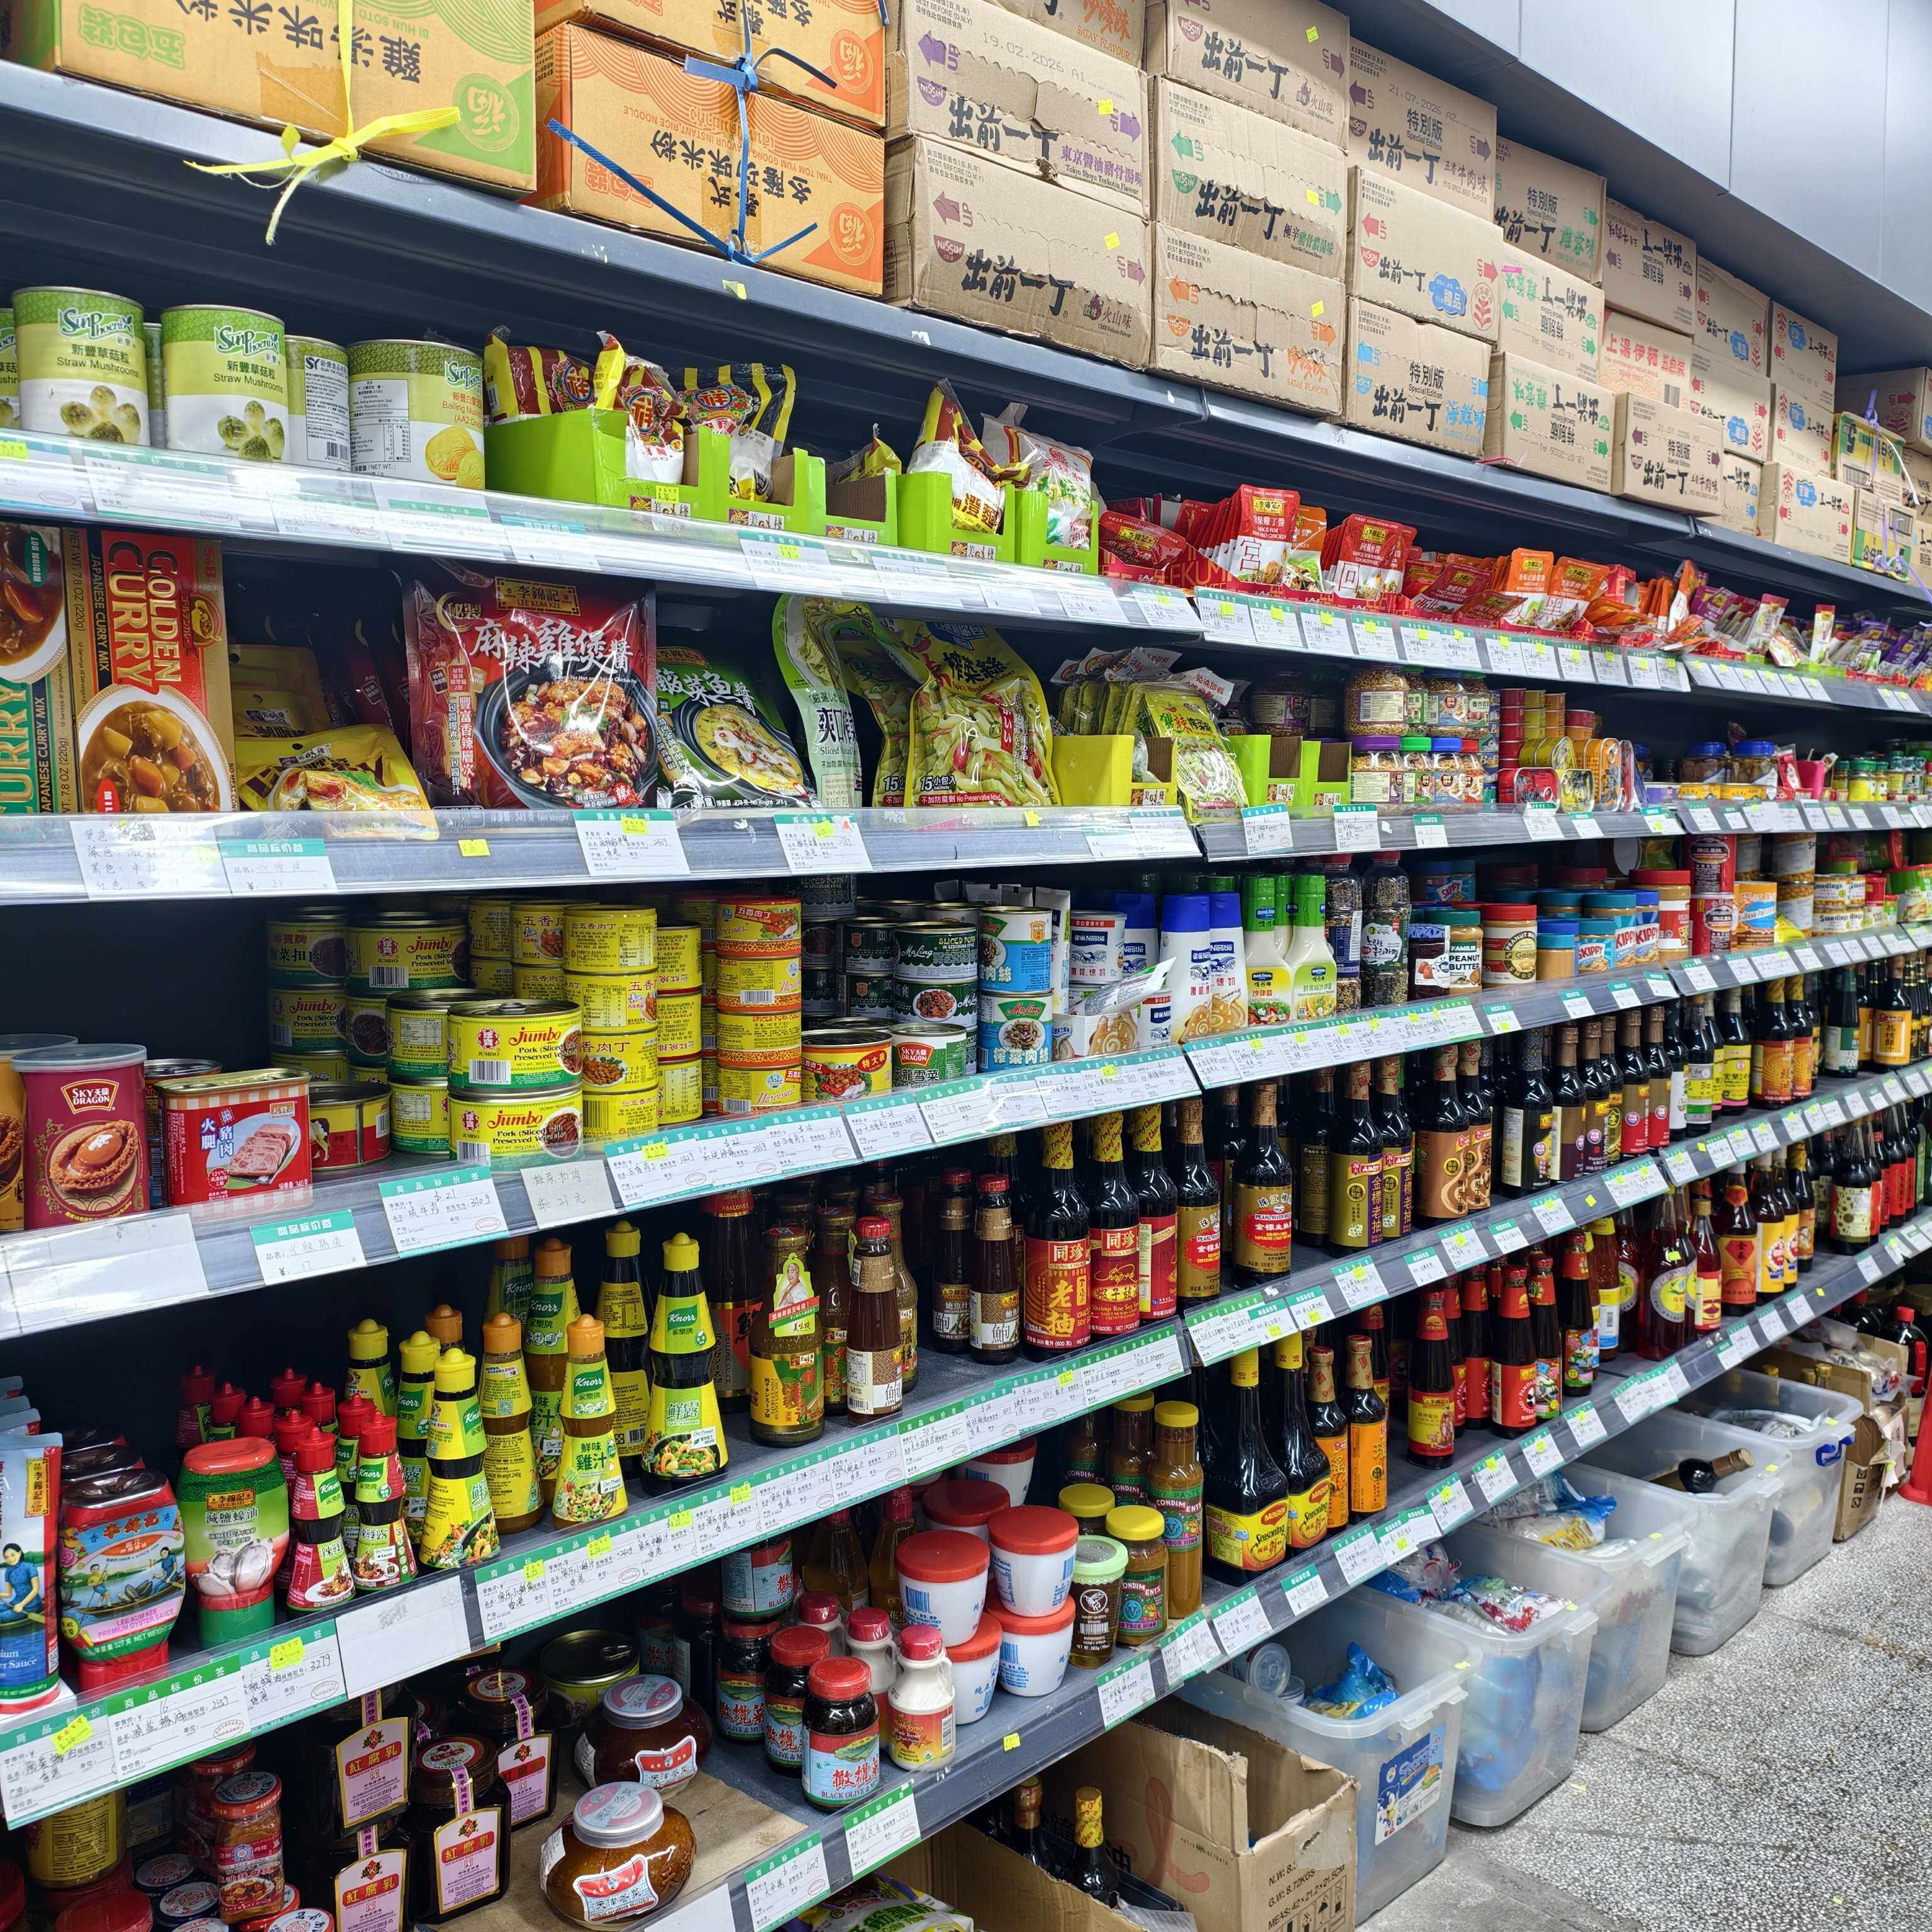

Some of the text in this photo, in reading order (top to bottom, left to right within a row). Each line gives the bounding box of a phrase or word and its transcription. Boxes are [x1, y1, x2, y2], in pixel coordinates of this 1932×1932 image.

[931, 3, 953, 18] BEFORE
[360, 10, 429, 39] BI HUN SOTO
[78, 4, 185, 69] 五包裝
[1077, 25, 1131, 61] SATAY FLAVOUR
[947, 43, 961, 71] UP
[982, 31, 1065, 73] 19.02.2026
[1322, 48, 1330, 70] UP
[1201, 30, 1289, 100] 出前一丁
[921, 83, 944, 99] NISSIN
[1367, 89, 1375, 110] UP
[948, 96, 1060, 161] 出前一丁
[1406, 107, 1443, 143] 特別版
[623, 105, 833, 184] THAI TOM YUM GOONG INSTANT RICE NOODLE
[1406, 130, 1426, 145] Special
[1367, 128, 1441, 185] 出前一丁
[943, 162, 965, 177] BEFORE
[1194, 179, 1285, 240] 出前一丁
[1526, 186, 1558, 216] 特別版
[962, 201, 974, 228] UP
[1379, 219, 1387, 241] UP
[1494, 205, 1557, 253] 出前一丁
[936, 238, 963, 256] NISSIN
[1641, 228, 1682, 269] 出前一丁
[1116, 255, 1126, 279] UP
[1379, 255, 1426, 293] 出前一丁
[960, 248, 1075, 316] 出前一丁
[1541, 276, 1588, 323] 出前一丁
[1101, 306, 1132, 330] 火山味
[71, 343, 131, 365] 新豐草菇粒
[1190, 323, 1275, 379] 出前一丁
[57, 357, 140, 378] Straw Mushrooms
[226, 360, 277, 381] 新豐草菇粒
[1409, 361, 1445, 391] 特別版
[213, 373, 284, 394] Straw Mushrooms
[1305, 383, 1330, 397] FLAVOUR
[1409, 383, 1443, 400] Special Edition
[442, 401, 465, 414] Bailing
[1372, 384, 1443, 433] 出前一丁
[1552, 383, 1599, 425] 出前一丁
[1667, 439, 1691, 461] 特別版
[1642, 459, 1689, 496] 出前一丁
[31, 553, 42, 582] MEDIUM
[517, 584, 561, 604] 李錦記
[517, 597, 562, 610] LEE KUM KEE
[91, 553, 109, 672] JAPANESE CURRY MIX
[108, 540, 153, 689] CURRY
[146, 550, 182, 682] GOLDEN
[469, 617, 634, 675] 麻辣雞煲醬
[34, 696, 49, 758] CURRY MIX
[58, 736, 69, 784] OZ (220g)
[819, 746, 840, 756] Sliced
[921, 794, 956, 805] 不加防腐劑
[1441, 881, 1462, 898] SKIPPY
[938, 937, 961, 945] SLICED
[1577, 942, 1604, 959] SKIPPY
[1448, 954, 1480, 963] PEANUT
[1448, 963, 1480, 971] BUTTER
[513, 1052, 552, 1061] Preserved
[901, 1046, 915, 1055] SKY
[901, 1053, 927, 1062] DRAGON
[894, 1069, 940, 1082] 天龍雪菜
[72, 1087, 94, 1099] SKY
[72, 1095, 110, 1106] DRAGON
[200, 1118, 216, 1151] 火腿
[218, 1123, 235, 1158] 豬肉
[492, 1136, 533, 1145] Preserved
[1361, 1164, 1380, 1173] AMOY
[1396, 1155, 1412, 1164] AMOY
[396, 1172, 484, 1194] 商品标价签
[1371, 1175, 1383, 1235] 金標老抽
[1106, 1231, 1135, 1250] 同珍
[1053, 1245, 1084, 1263] 同珍
[669, 1312, 696, 1324] Knorr
[1045, 1279, 1076, 1338] 老抽
[1092, 1304, 1112, 1313] Shrimp
[672, 1327, 693, 1335] 家樂牌
[574, 1376, 603, 1388] Knorr
[666, 1401, 699, 1421] 鮮露
[906, 1406, 957, 1431] 商品标价签
[580, 1442, 602, 1453] 鮮味
[575, 1453, 608, 1470] 雞汁
[359, 1468, 382, 1480] Knorr
[218, 1493, 245, 1504] 李錦記
[1310, 1484, 1331, 1502] Maggi
[204, 1507, 258, 1524] 減鹽蠔油
[1156, 1499, 1202, 1513] CONDIMENTS
[1263, 1507, 1285, 1524] Maggi
[1304, 1501, 1328, 1523] Seasoning
[102, 1511, 160, 1541] 李錦記
[1255, 1524, 1285, 1545] Seasoning
[1121, 1581, 1161, 1597] ONDIMENTS
[768, 1598, 785, 1609] BLACK
[97, 1609, 175, 1638] PREMIUM OYSTER SAUCE
[116, 1607, 158, 1626] LEE KUM KEE
[147, 1627, 168, 1641] WEIGHT
[8, 1658, 38, 1669] Sauce
[124, 1665, 226, 1709] 商品标价签
[347, 1745, 397, 1774] 紅腐乳
[772, 1750, 788, 1761] OLIVE
[648, 1767, 688, 1786] 天津冬菜
[821, 1786, 865, 1801] BLACK OLIVE
[444, 1835, 491, 1861] 紅腐乳
[755, 1840, 813, 1879] 商品标价签
[1268, 1868, 1285, 1887] N.W:
[346, 1879, 396, 1903] 紅腐乳
[594, 1887, 642, 1911] 天津冬菜
[1268, 1869, 1316, 1908] G.W: 8.72KGS
[1267, 1906, 1291, 1930] MEAS:
